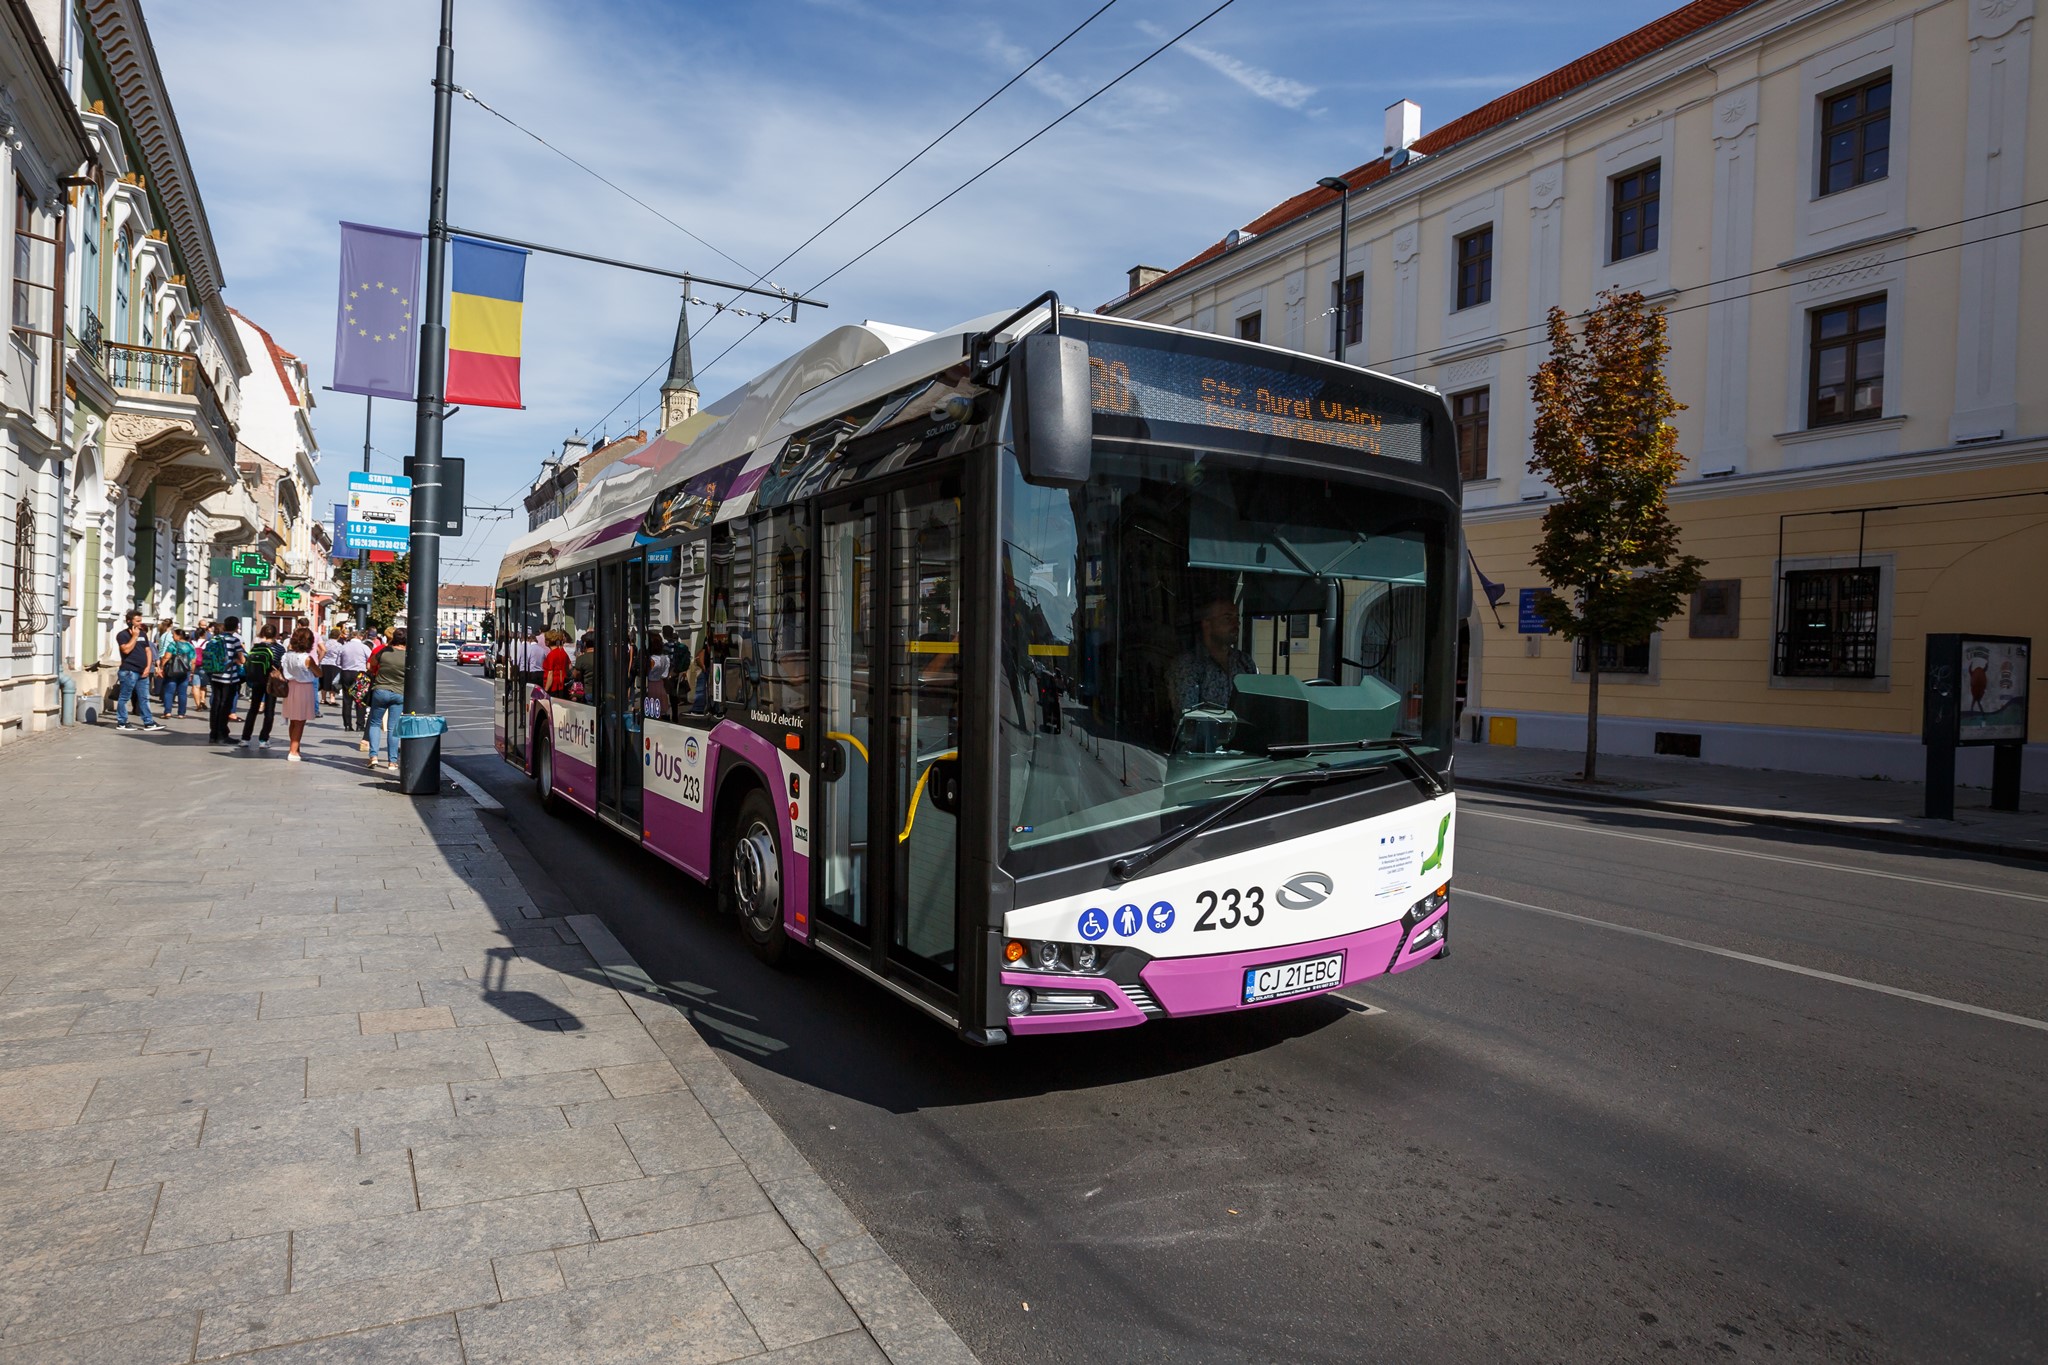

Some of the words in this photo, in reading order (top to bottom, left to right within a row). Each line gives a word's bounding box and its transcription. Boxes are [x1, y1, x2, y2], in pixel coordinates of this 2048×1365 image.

[1201, 376, 1246, 410] Str.
[1256, 387, 1313, 420] Aurel
[1320, 400, 1382, 432] Vlaicu
[350, 524, 355, 532] 1
[355, 524, 361, 533] 6
[362, 525, 367, 533] 7
[368, 525, 377, 534] 25
[558, 715, 589, 748] electric
[750, 709, 770, 723] Urbino
[770, 712, 778, 725] 12
[778, 713, 804, 729] electric
[655, 742, 682, 783] bus
[683, 774, 700, 803] 233
[1193, 886, 1265, 932] 233
[1259, 970, 1281, 992] CJ
